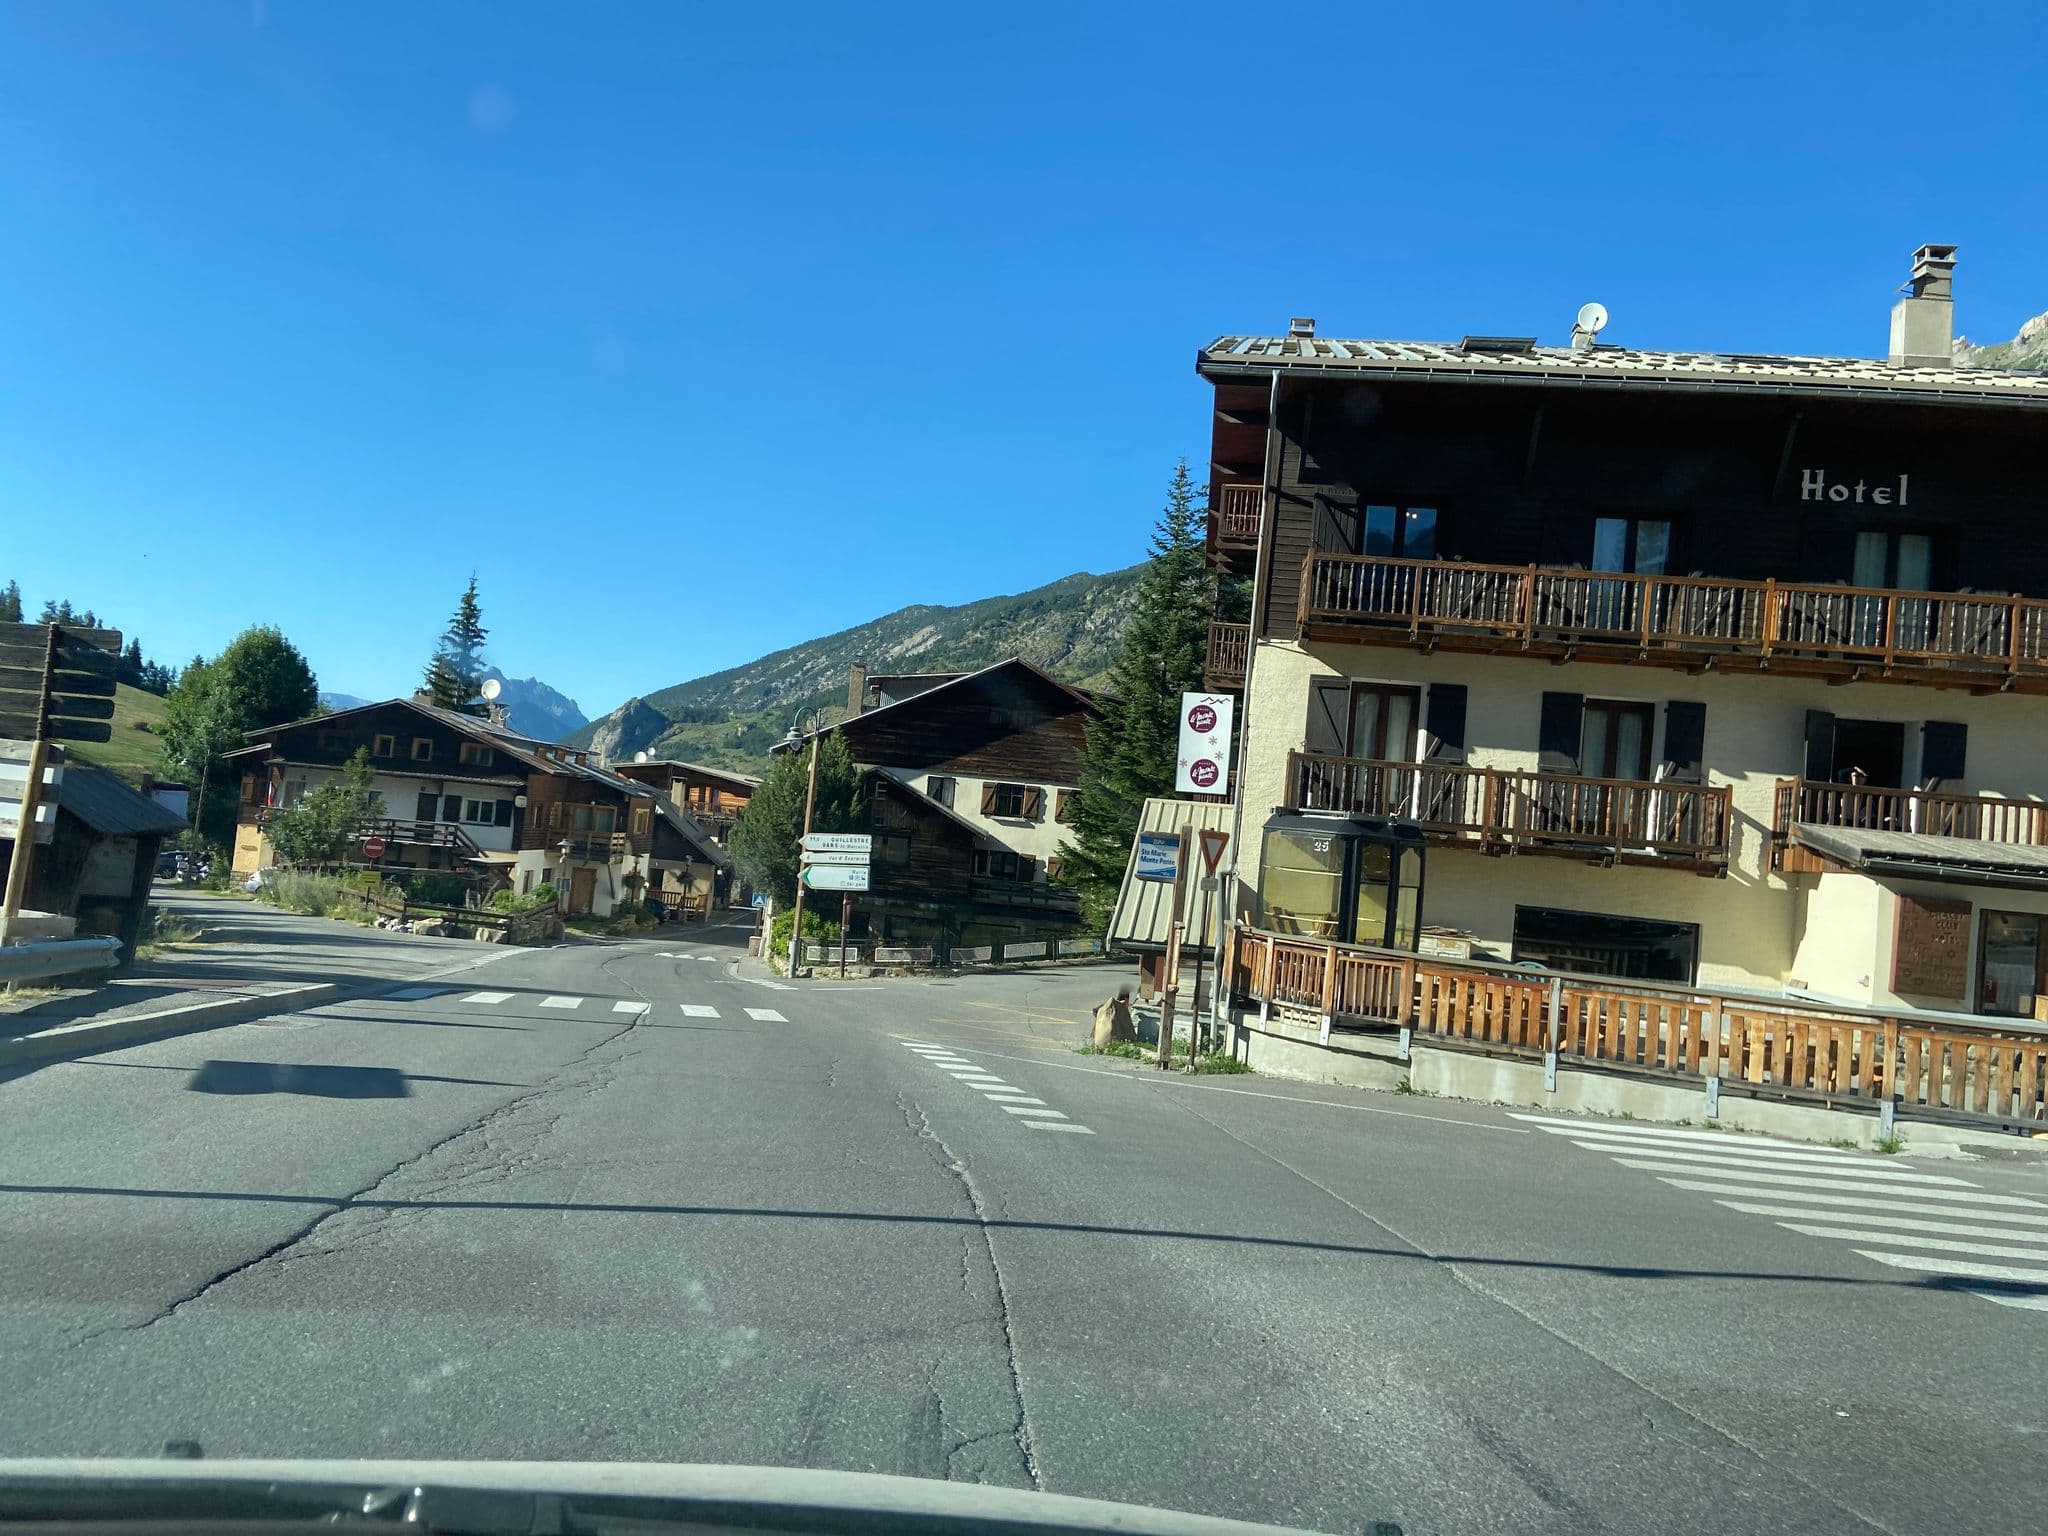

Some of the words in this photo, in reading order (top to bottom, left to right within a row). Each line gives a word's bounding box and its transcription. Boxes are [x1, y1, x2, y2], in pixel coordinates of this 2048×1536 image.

[1802, 469, 1908, 506] Hotel
[1313, 840, 1329, 852] 25
[1141, 848, 1151, 856] Ste
[1151, 849, 1167, 857] Marie
[1140, 856, 1158, 864] Monte
